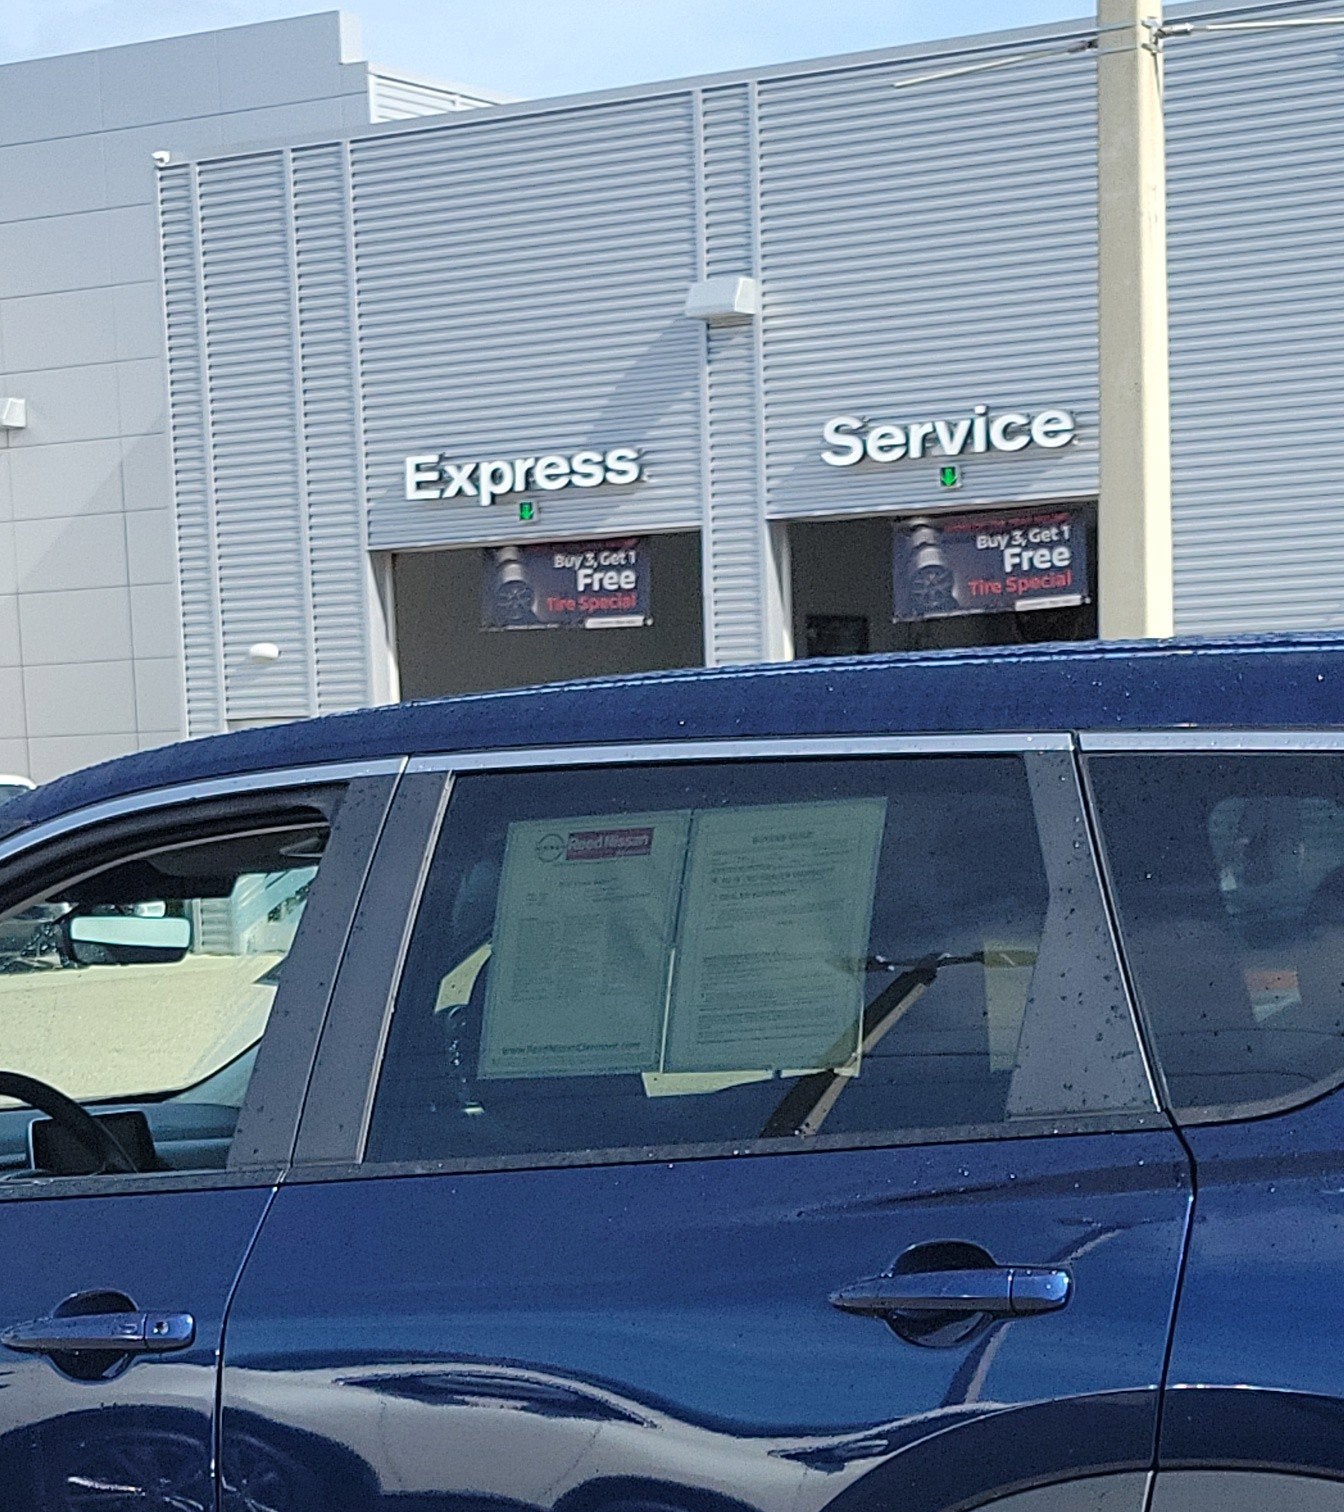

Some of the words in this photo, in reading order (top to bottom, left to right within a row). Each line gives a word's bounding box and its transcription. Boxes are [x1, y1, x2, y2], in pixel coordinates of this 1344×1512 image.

[820, 404, 1076, 466] Service
[405, 448, 641, 507] Express
[976, 533, 1010, 550] Buy
[1011, 529, 1027, 547] 3,
[1028, 528, 1060, 544] Get
[1060, 525, 1071, 540] 1
[553, 554, 584, 571] Buy
[584, 551, 598, 568] 3,
[599, 550, 627, 566] Get
[1003, 546, 1072, 572] Free
[577, 568, 637, 592] Free
[968, 579, 1002, 596] Tire
[1006, 569, 1073, 595] Special
[547, 596, 577, 612] Tire
[578, 592, 638, 613] Special
